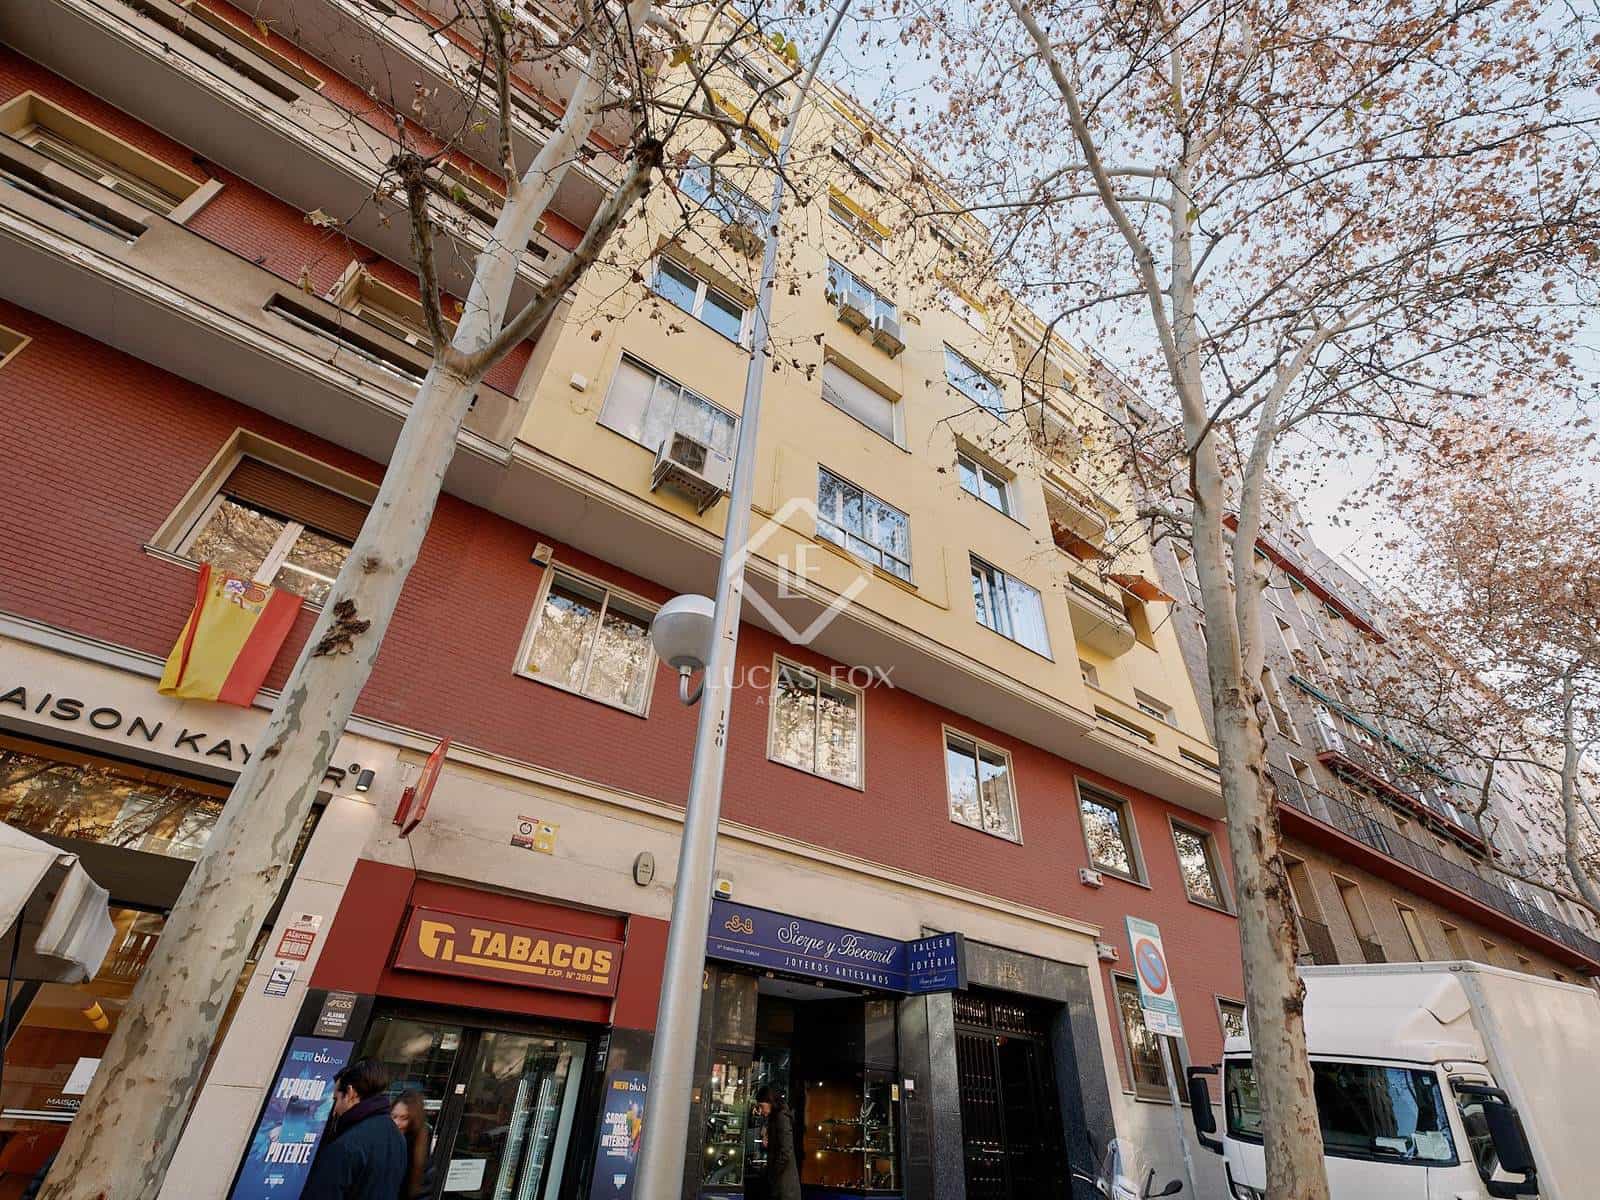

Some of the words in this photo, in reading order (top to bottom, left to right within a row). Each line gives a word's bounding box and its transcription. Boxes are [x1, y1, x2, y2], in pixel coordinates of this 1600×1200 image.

[0, 686, 163, 742] AISON
[470, 928, 613, 974] TABACOS
[777, 921, 824, 954] Sierpe
[824, 941, 836, 959] y
[838, 934, 897, 965] Becerril
[913, 938, 951, 953] TALLER
[785, 956, 829, 973] JOYEROS
[836, 967, 889, 985] ARTESANOS
[264, 1142, 313, 1164] POTENTE
